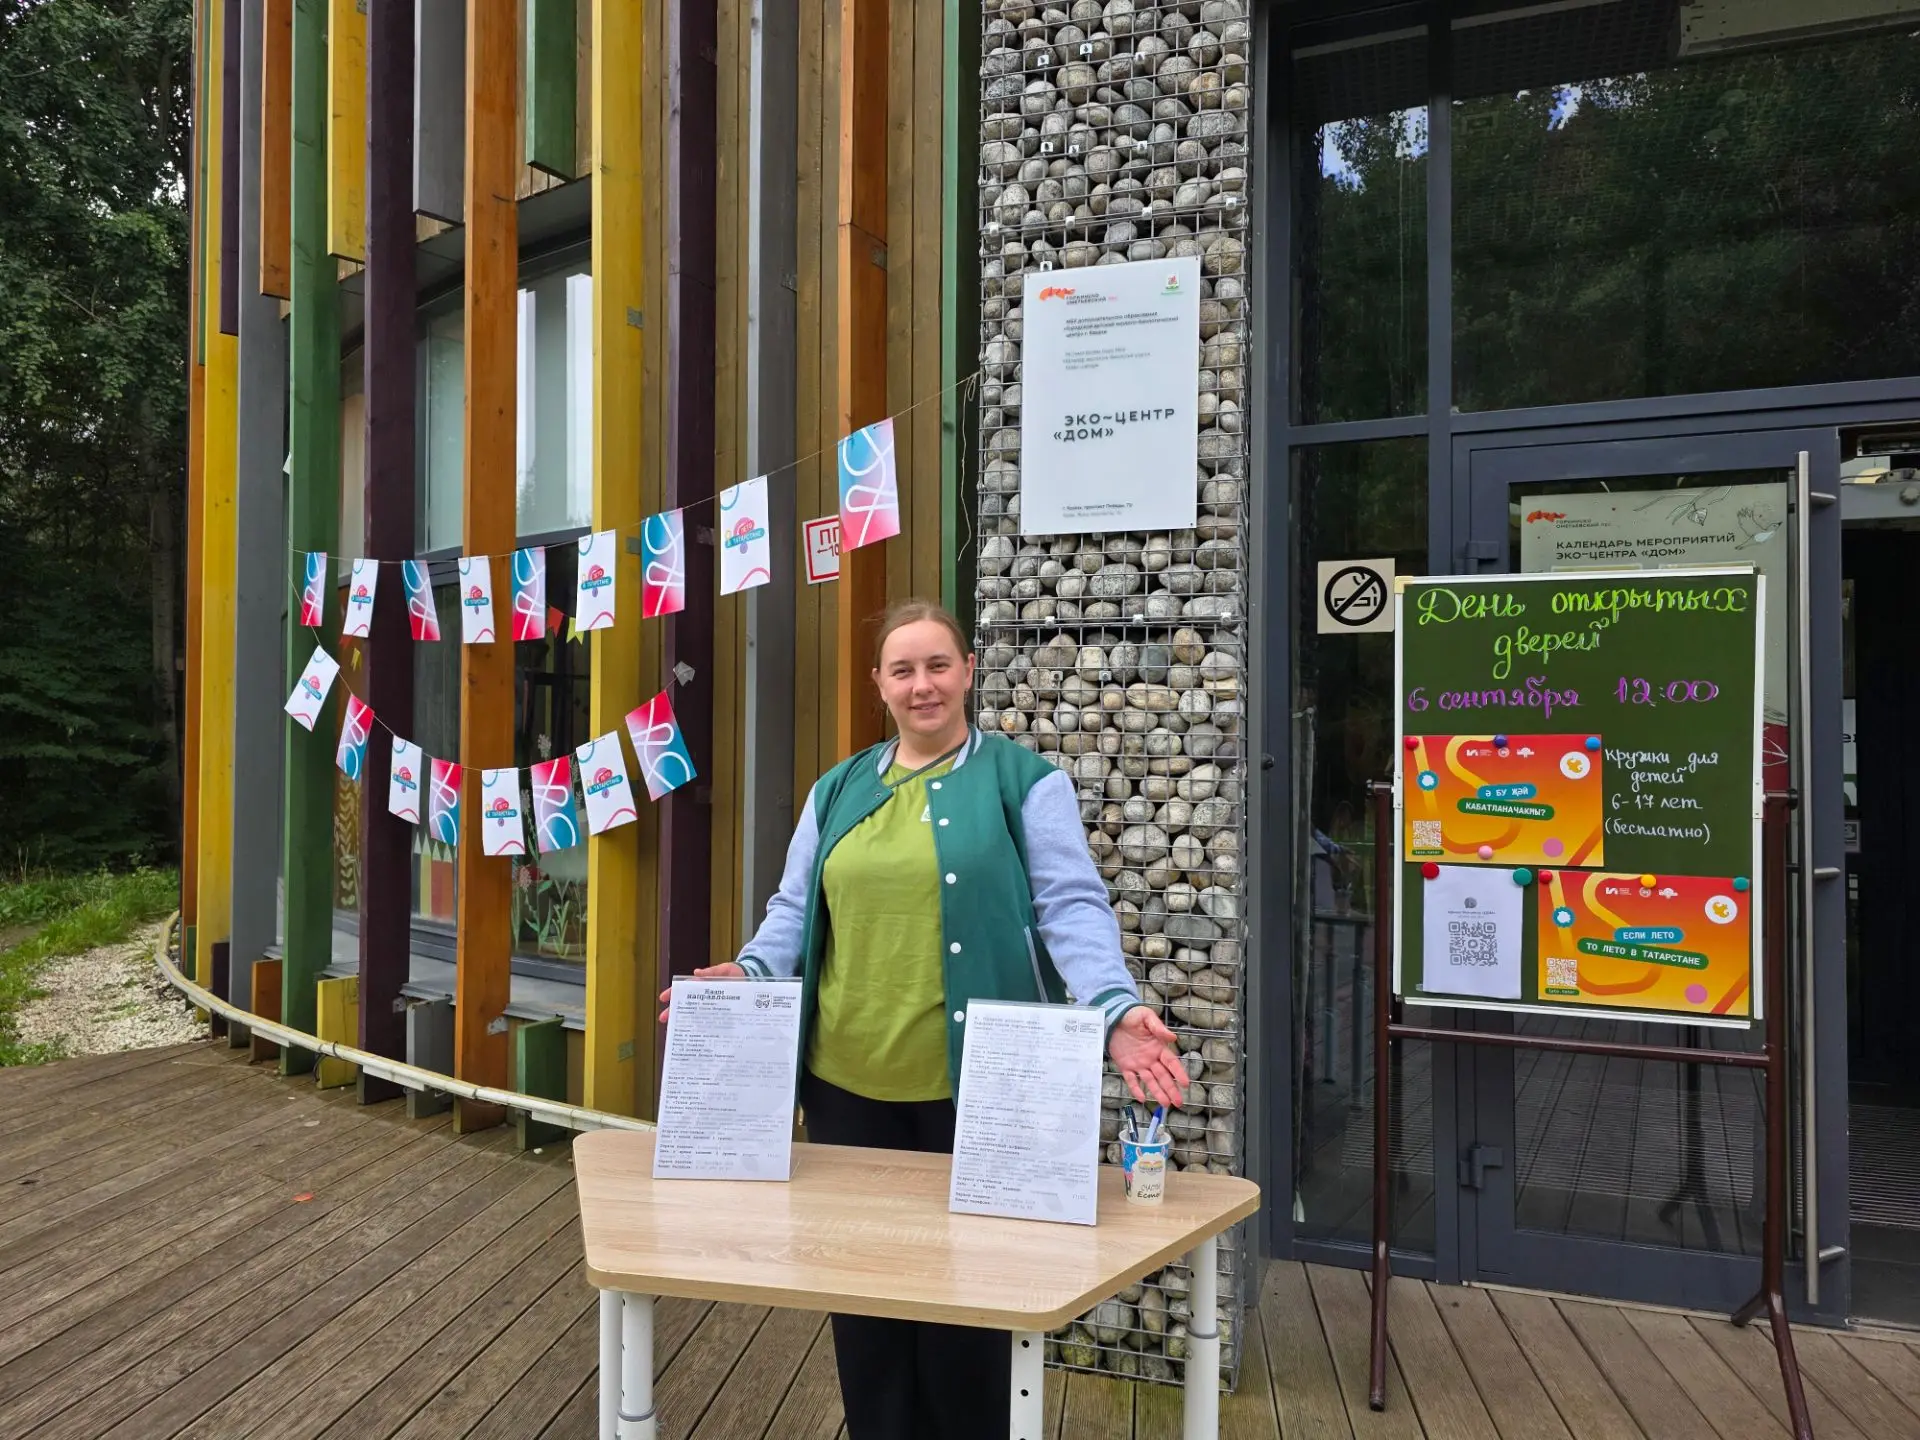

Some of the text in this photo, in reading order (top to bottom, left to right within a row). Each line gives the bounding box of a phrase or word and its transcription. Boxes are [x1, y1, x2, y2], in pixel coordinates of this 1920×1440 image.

[1053, 427, 1114, 442] «ДОМ»
[1556, 533, 1736, 551] КАЛЕНДАРЬ МЕРОПРИЯТИЙ
[1641, 548, 1687, 559] «ДОМ»
[1417, 587, 1748, 625] День открытых
[1492, 617, 1610, 680] дверей
[1408, 675, 1720, 720] 6 сентября 12:00
[1687, 752, 1719, 774] для
[1630, 766, 1688, 793] детей
[1495, 788, 1507, 798] БУ
[1660, 796, 1703, 810] лет
[1465, 801, 1547, 817] КАБАТЛАНАЧАКМЫ?
[1604, 817, 1711, 845] (бесплатно)
[1623, 930, 1675, 940] ЕСЛИ ЛЕТО
[1587, 942, 1702, 967] ТО ЛЕТО В ТАТАРСТАНЕ
